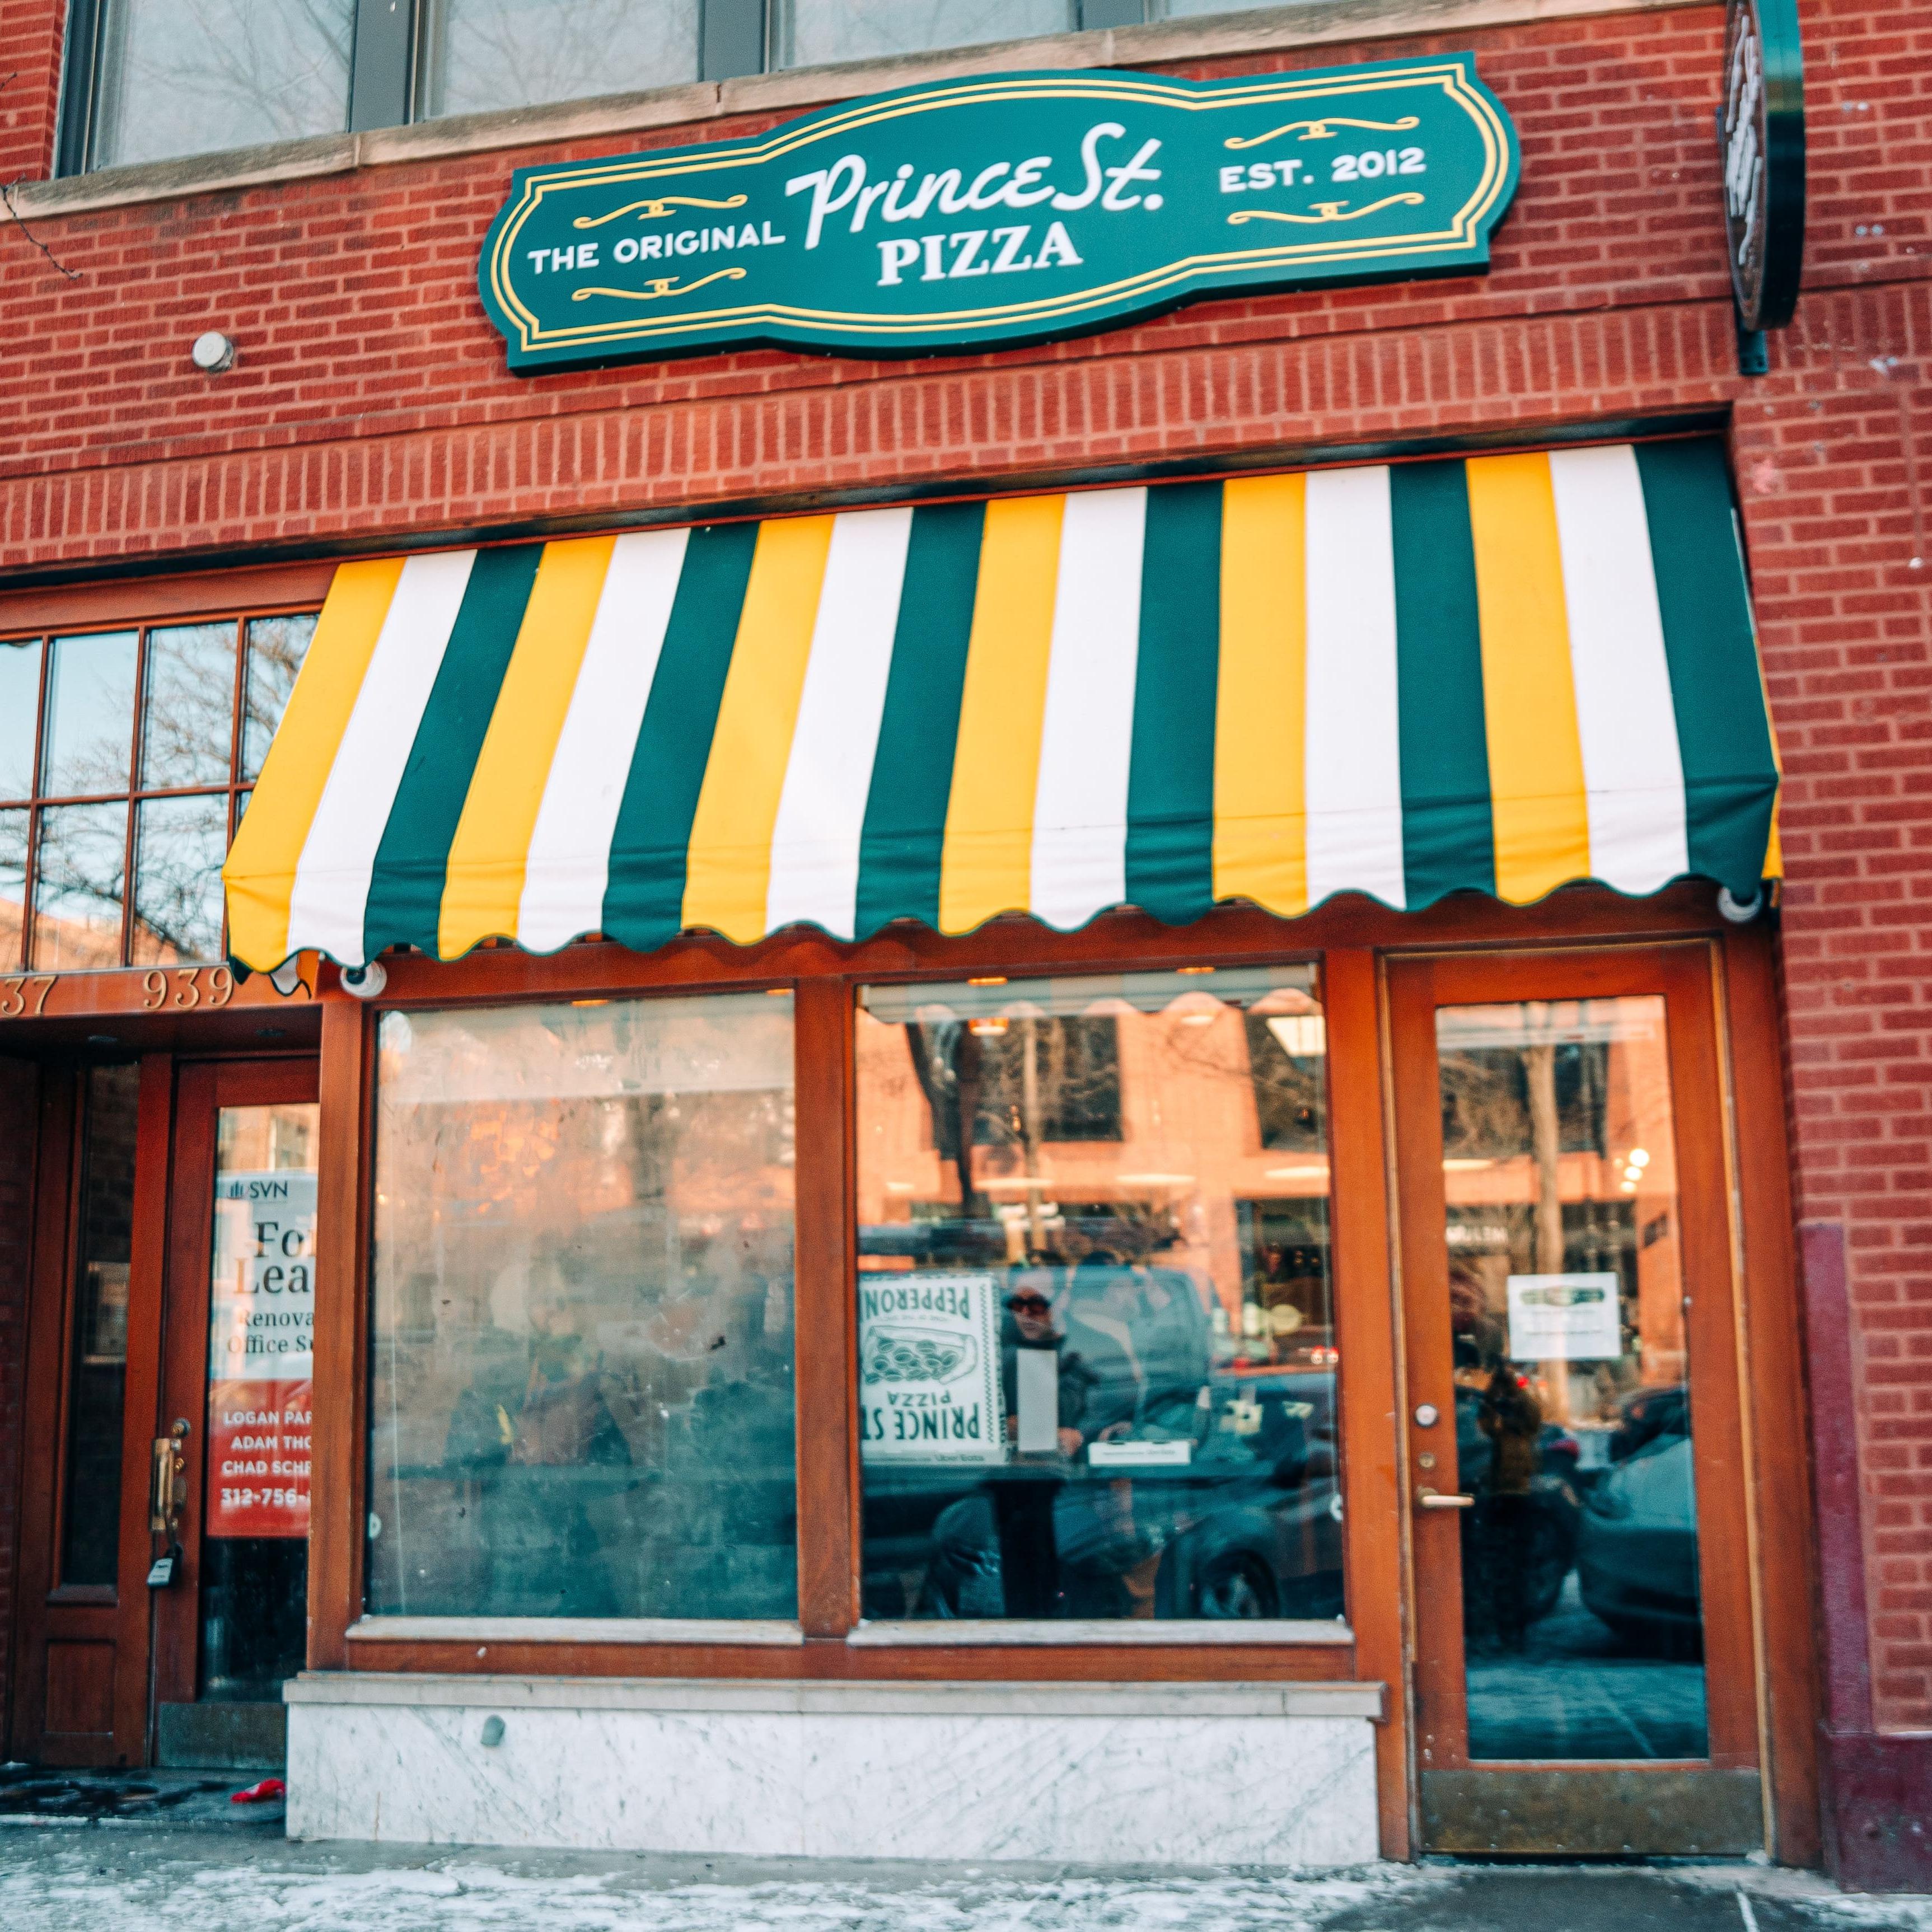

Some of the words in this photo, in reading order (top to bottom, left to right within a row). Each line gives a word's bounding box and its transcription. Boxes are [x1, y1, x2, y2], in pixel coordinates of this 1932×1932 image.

[785, 154, 1055, 250] Prince
[1050, 121, 1164, 212] St.
[1219, 159, 1314, 193] EST.
[1331, 147, 1426, 182] 2012
[527, 242, 600, 275] THE
[613, 221, 786, 264] ORIGINAL
[877, 221, 1084, 286] PIZZA
[143, 966, 233, 1009] 939
[250, 1180, 288, 1199] SVN
[233, 1258, 311, 1294] Lea
[227, 1335, 288, 1354] Office
[887, 1390, 952, 1407] PIZZA
[223, 1411, 280, 1426] LOGAN
[894, 1402, 982, 1440] PRINCE
[221, 1460, 268, 1476] CHAD
[220, 1487, 311, 1508] 312-756-
